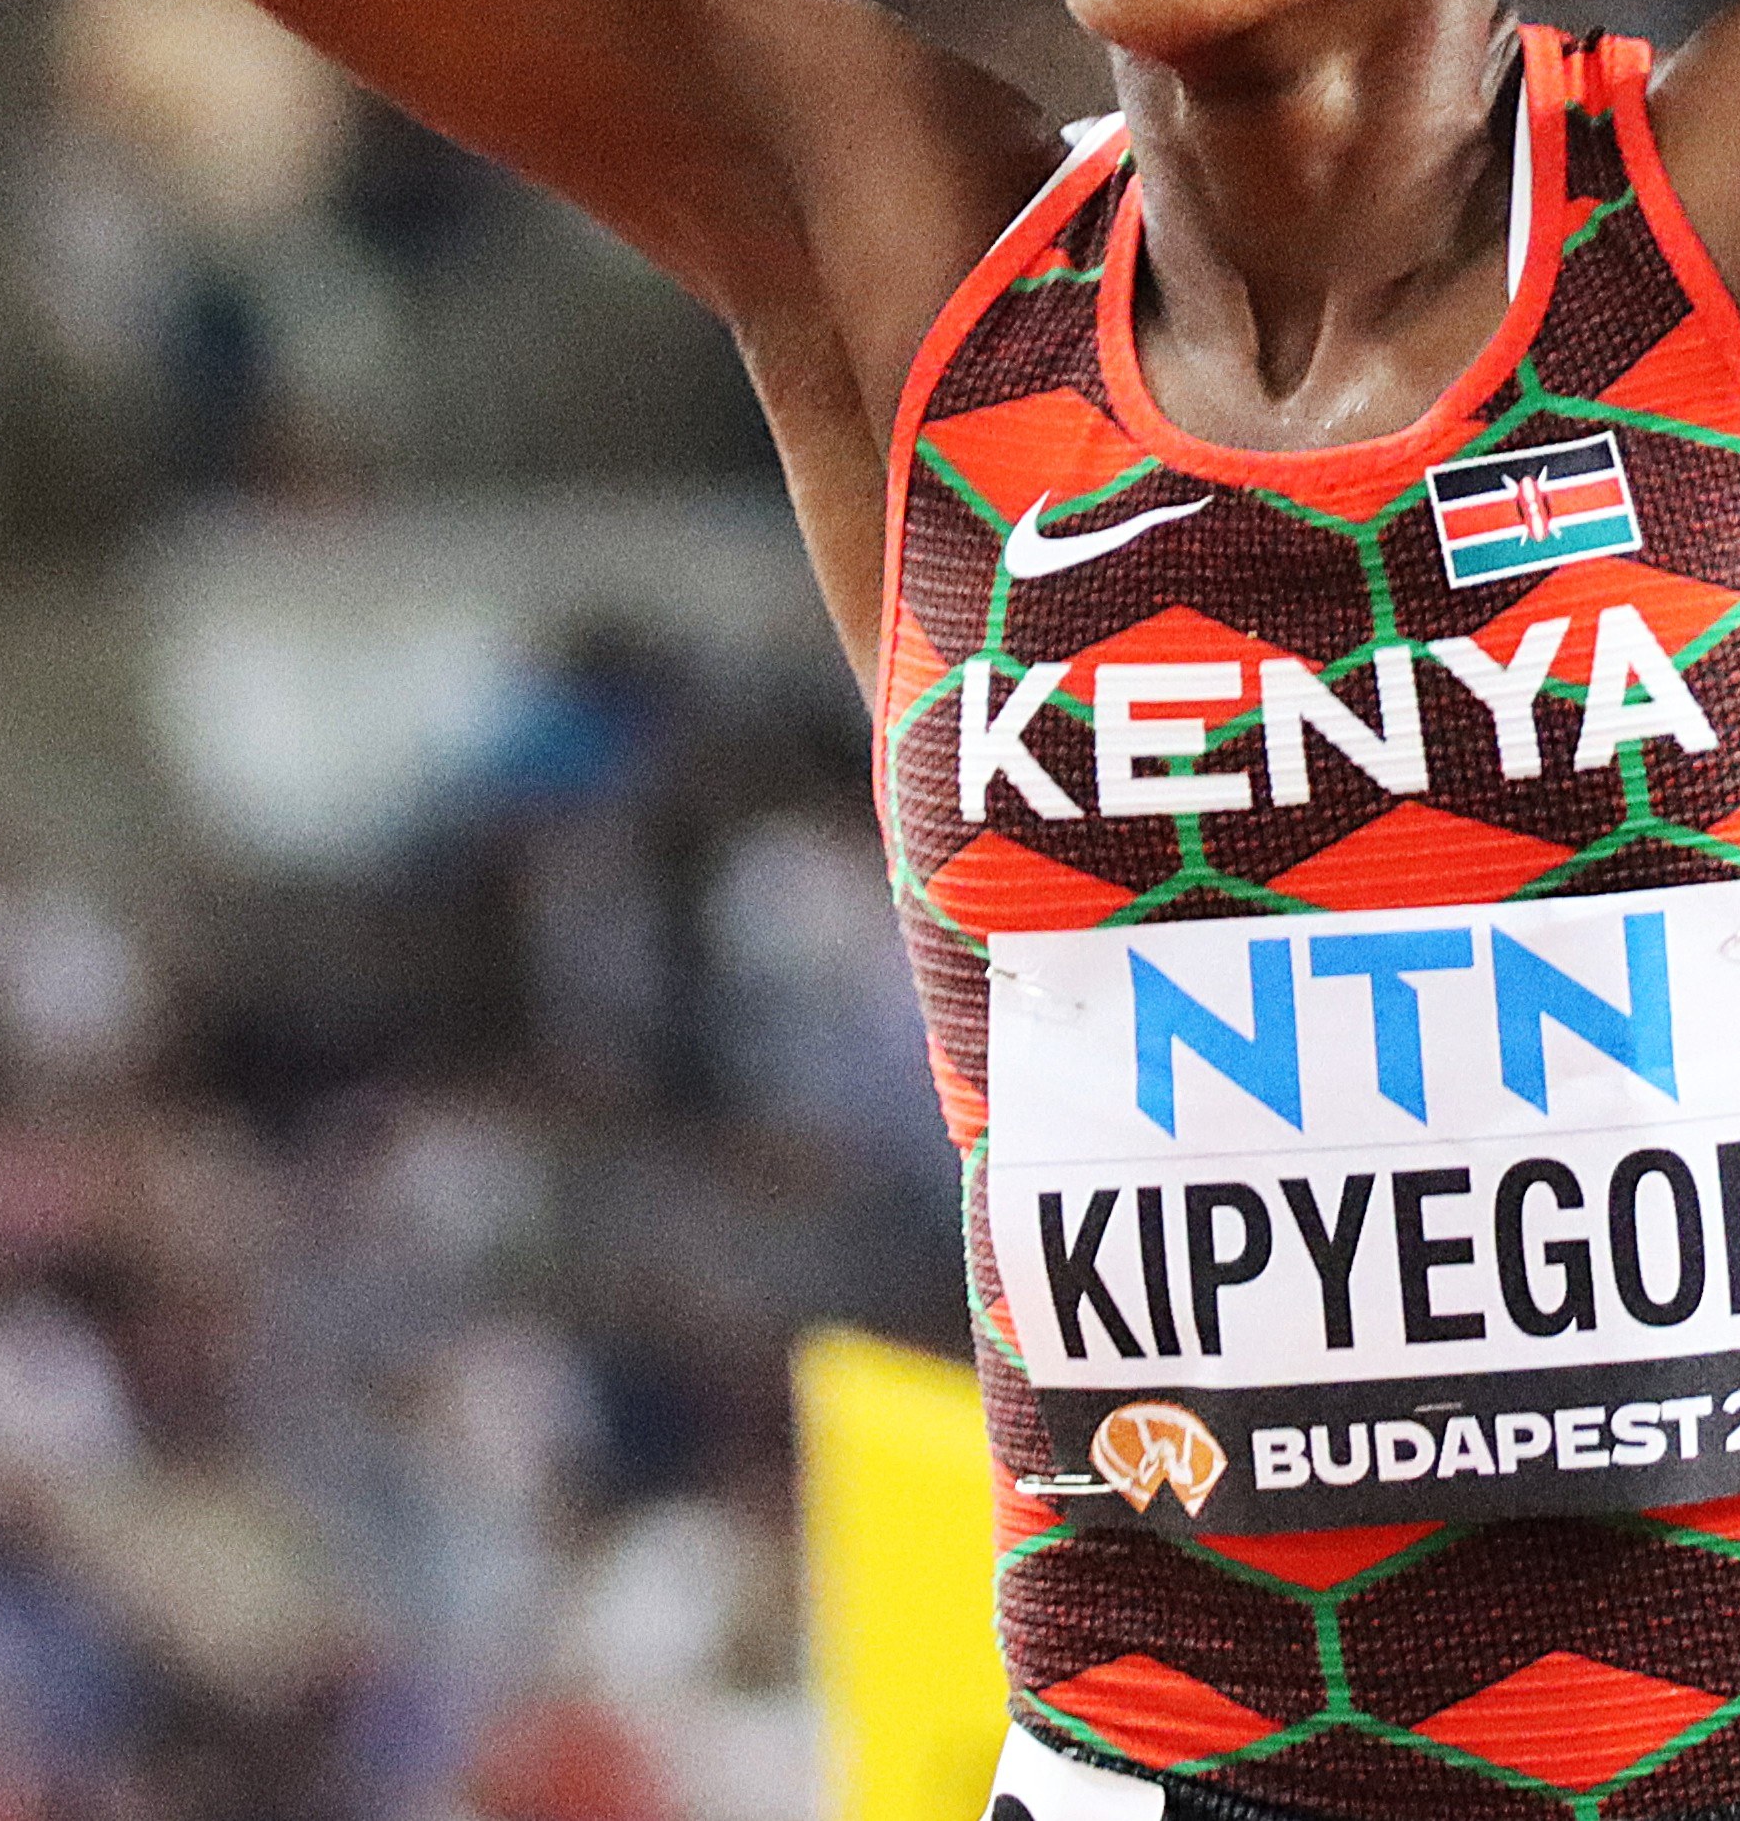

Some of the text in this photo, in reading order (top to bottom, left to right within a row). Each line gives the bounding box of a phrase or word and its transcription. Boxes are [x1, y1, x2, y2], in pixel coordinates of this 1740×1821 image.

[954, 602, 1720, 824] KENYA
[1126, 910, 1680, 1138] NTN
[1250, 1394, 1716, 1492] BUDAPEST
